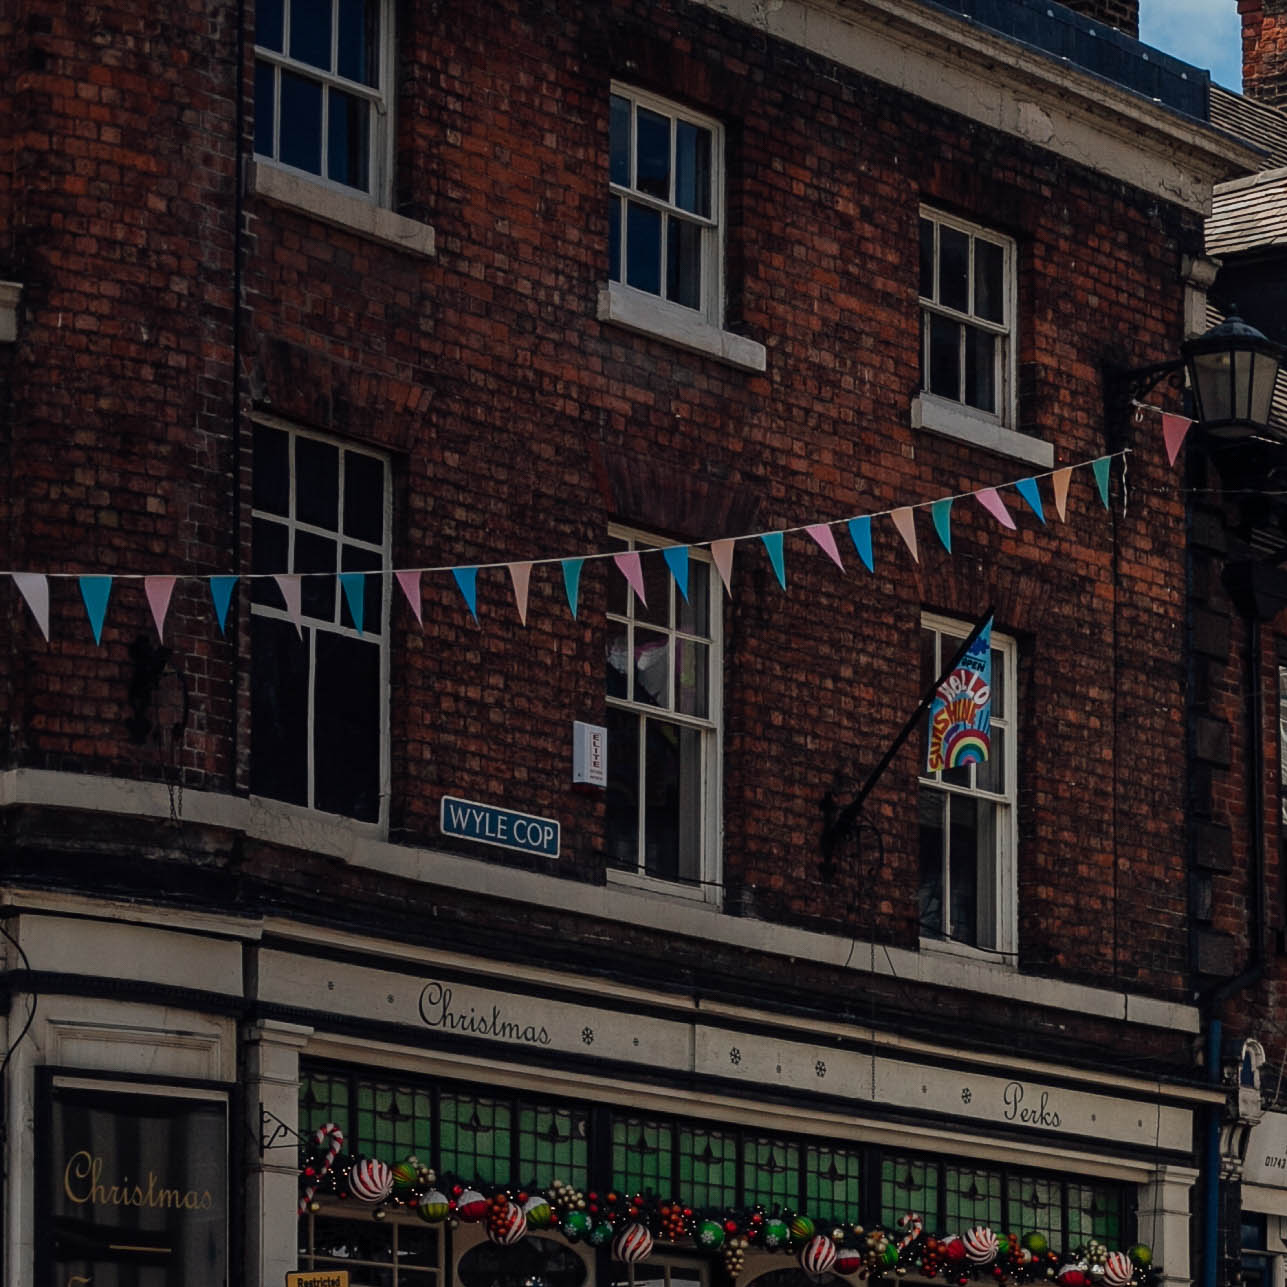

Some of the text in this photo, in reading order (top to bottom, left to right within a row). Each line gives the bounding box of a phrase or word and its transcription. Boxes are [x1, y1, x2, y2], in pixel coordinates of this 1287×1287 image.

[449, 804, 554, 849] WYLE COP
[418, 981, 552, 1046] Christmas
[1002, 1081, 1062, 1129] Perks
[64, 1150, 213, 1210] Christmas
[1265, 1155, 1287, 1169] 01743
